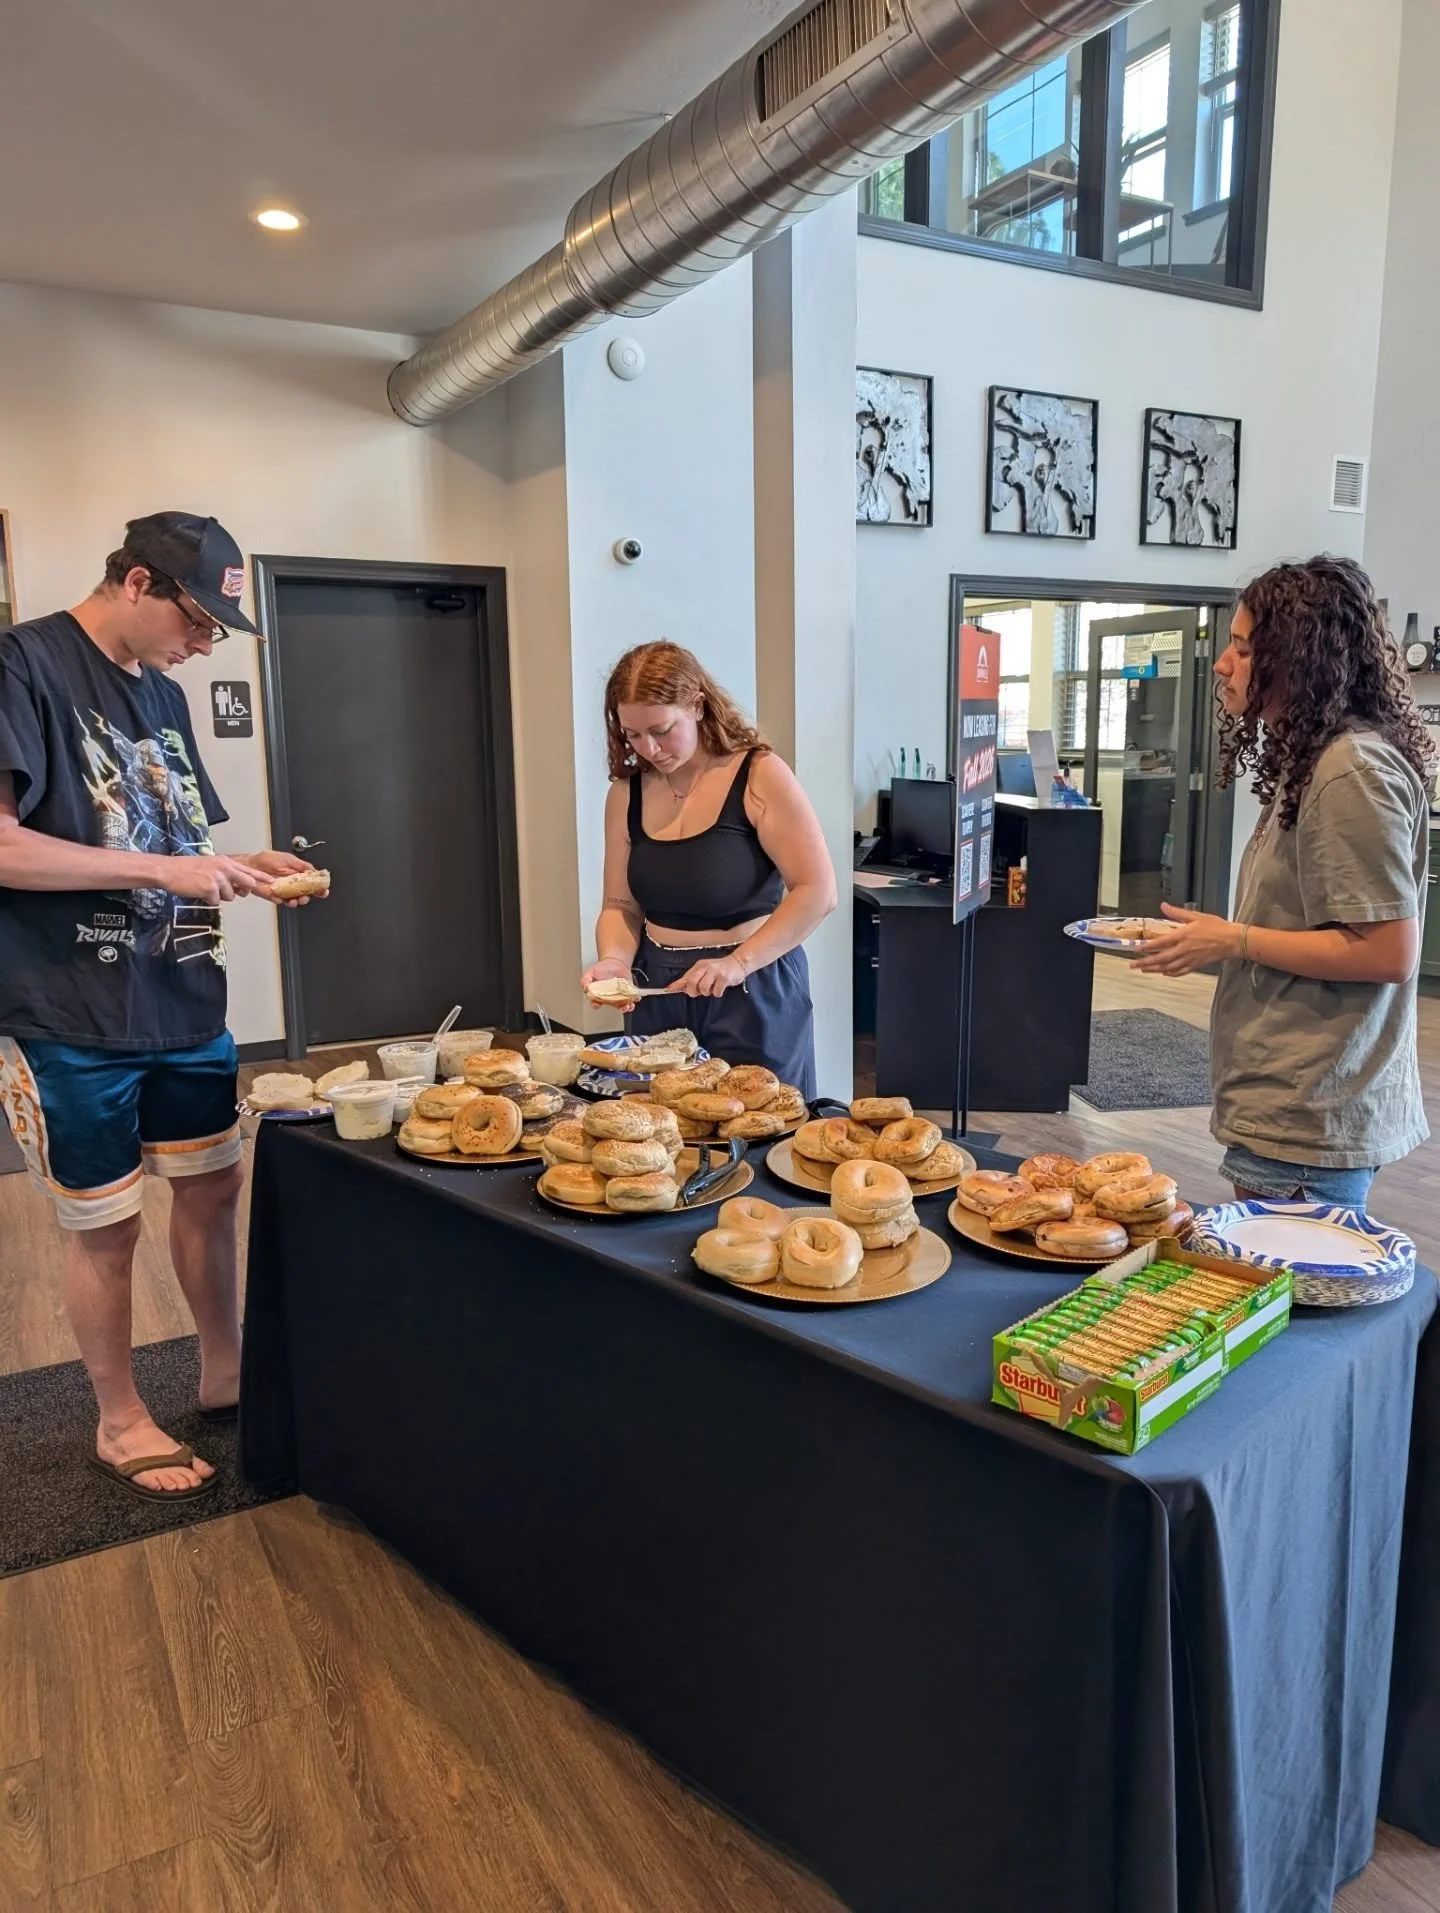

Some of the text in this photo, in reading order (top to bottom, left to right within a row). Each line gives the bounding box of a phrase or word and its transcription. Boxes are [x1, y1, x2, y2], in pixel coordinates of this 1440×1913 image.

[95, 915, 125, 926] MARVEL
[76, 924, 135, 947] RIVALS
[1001, 1363, 1086, 1415] Starbut
[1140, 1373, 1168, 1401] Starburst
